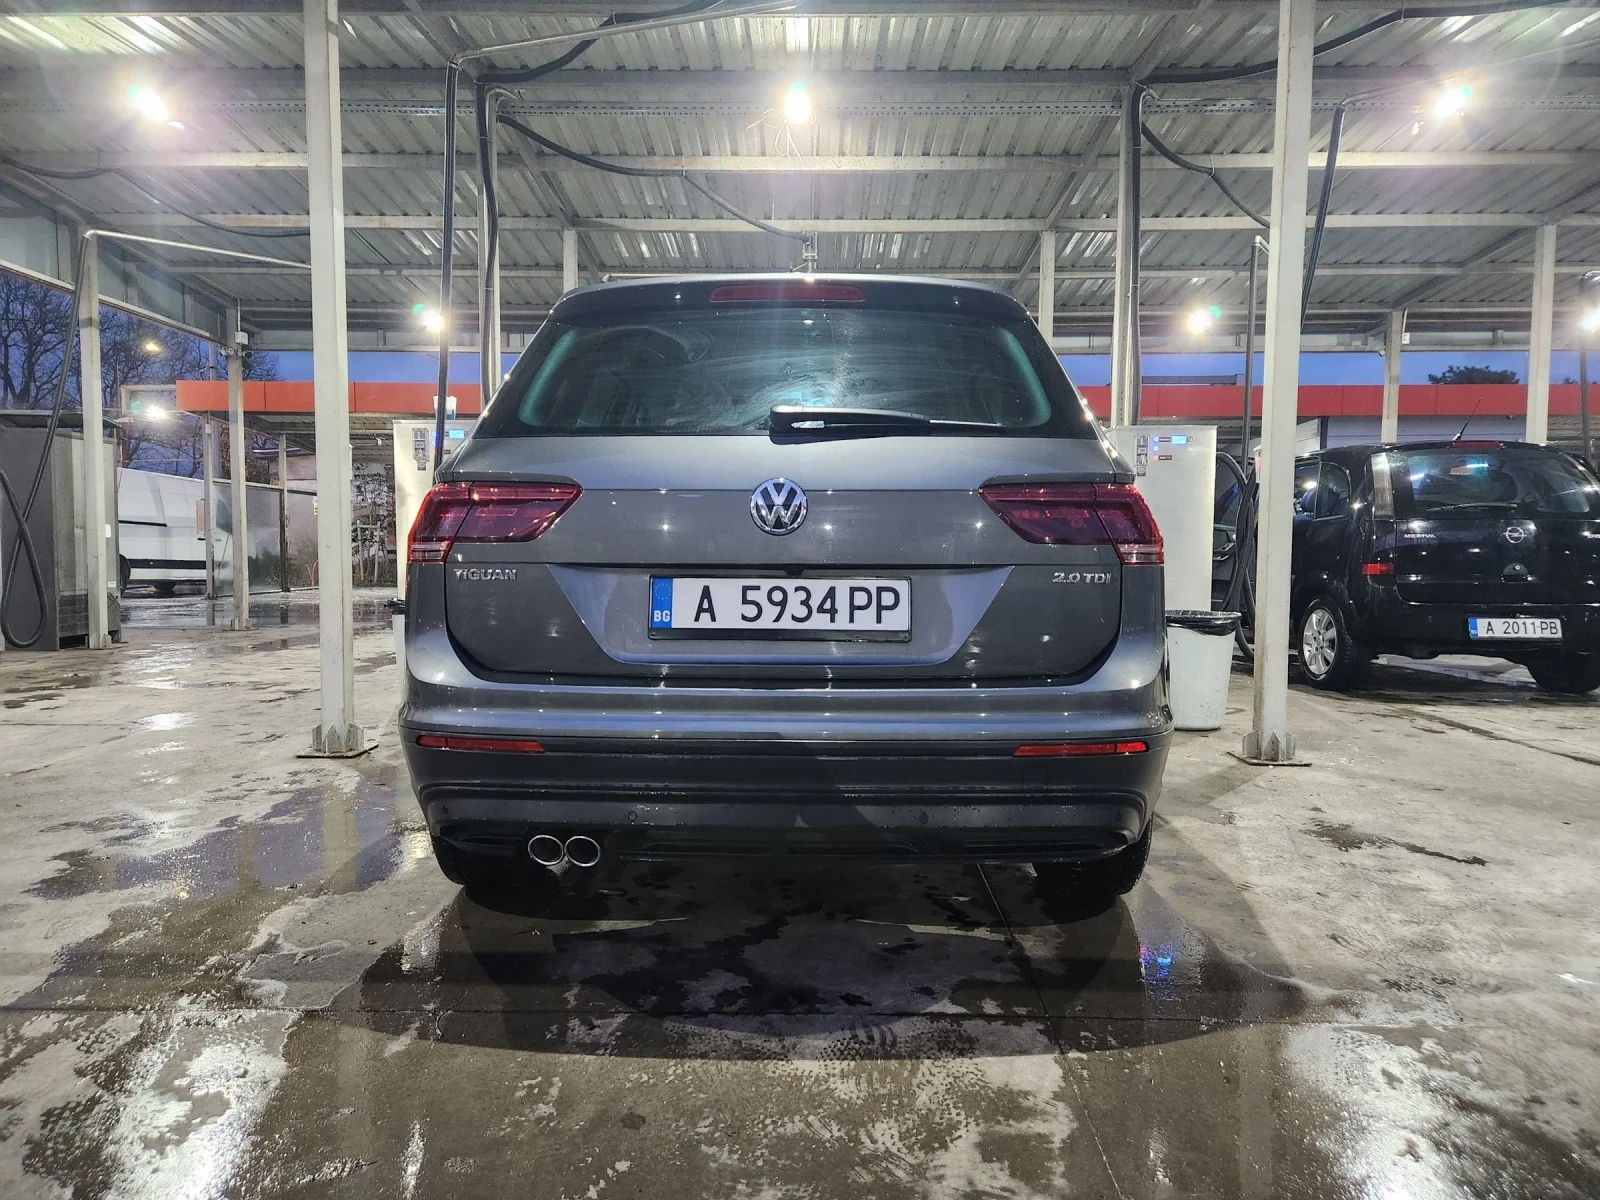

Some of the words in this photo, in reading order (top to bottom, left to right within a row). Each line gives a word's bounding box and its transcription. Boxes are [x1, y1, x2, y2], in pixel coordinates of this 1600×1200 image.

[453, 568, 517, 581] TIGUAN
[1052, 572, 1081, 583] 2.0
[1083, 572, 1112, 584] TDI
[693, 585, 717, 623] A
[653, 610, 671, 622] BG
[1486, 621, 1495, 635] A
